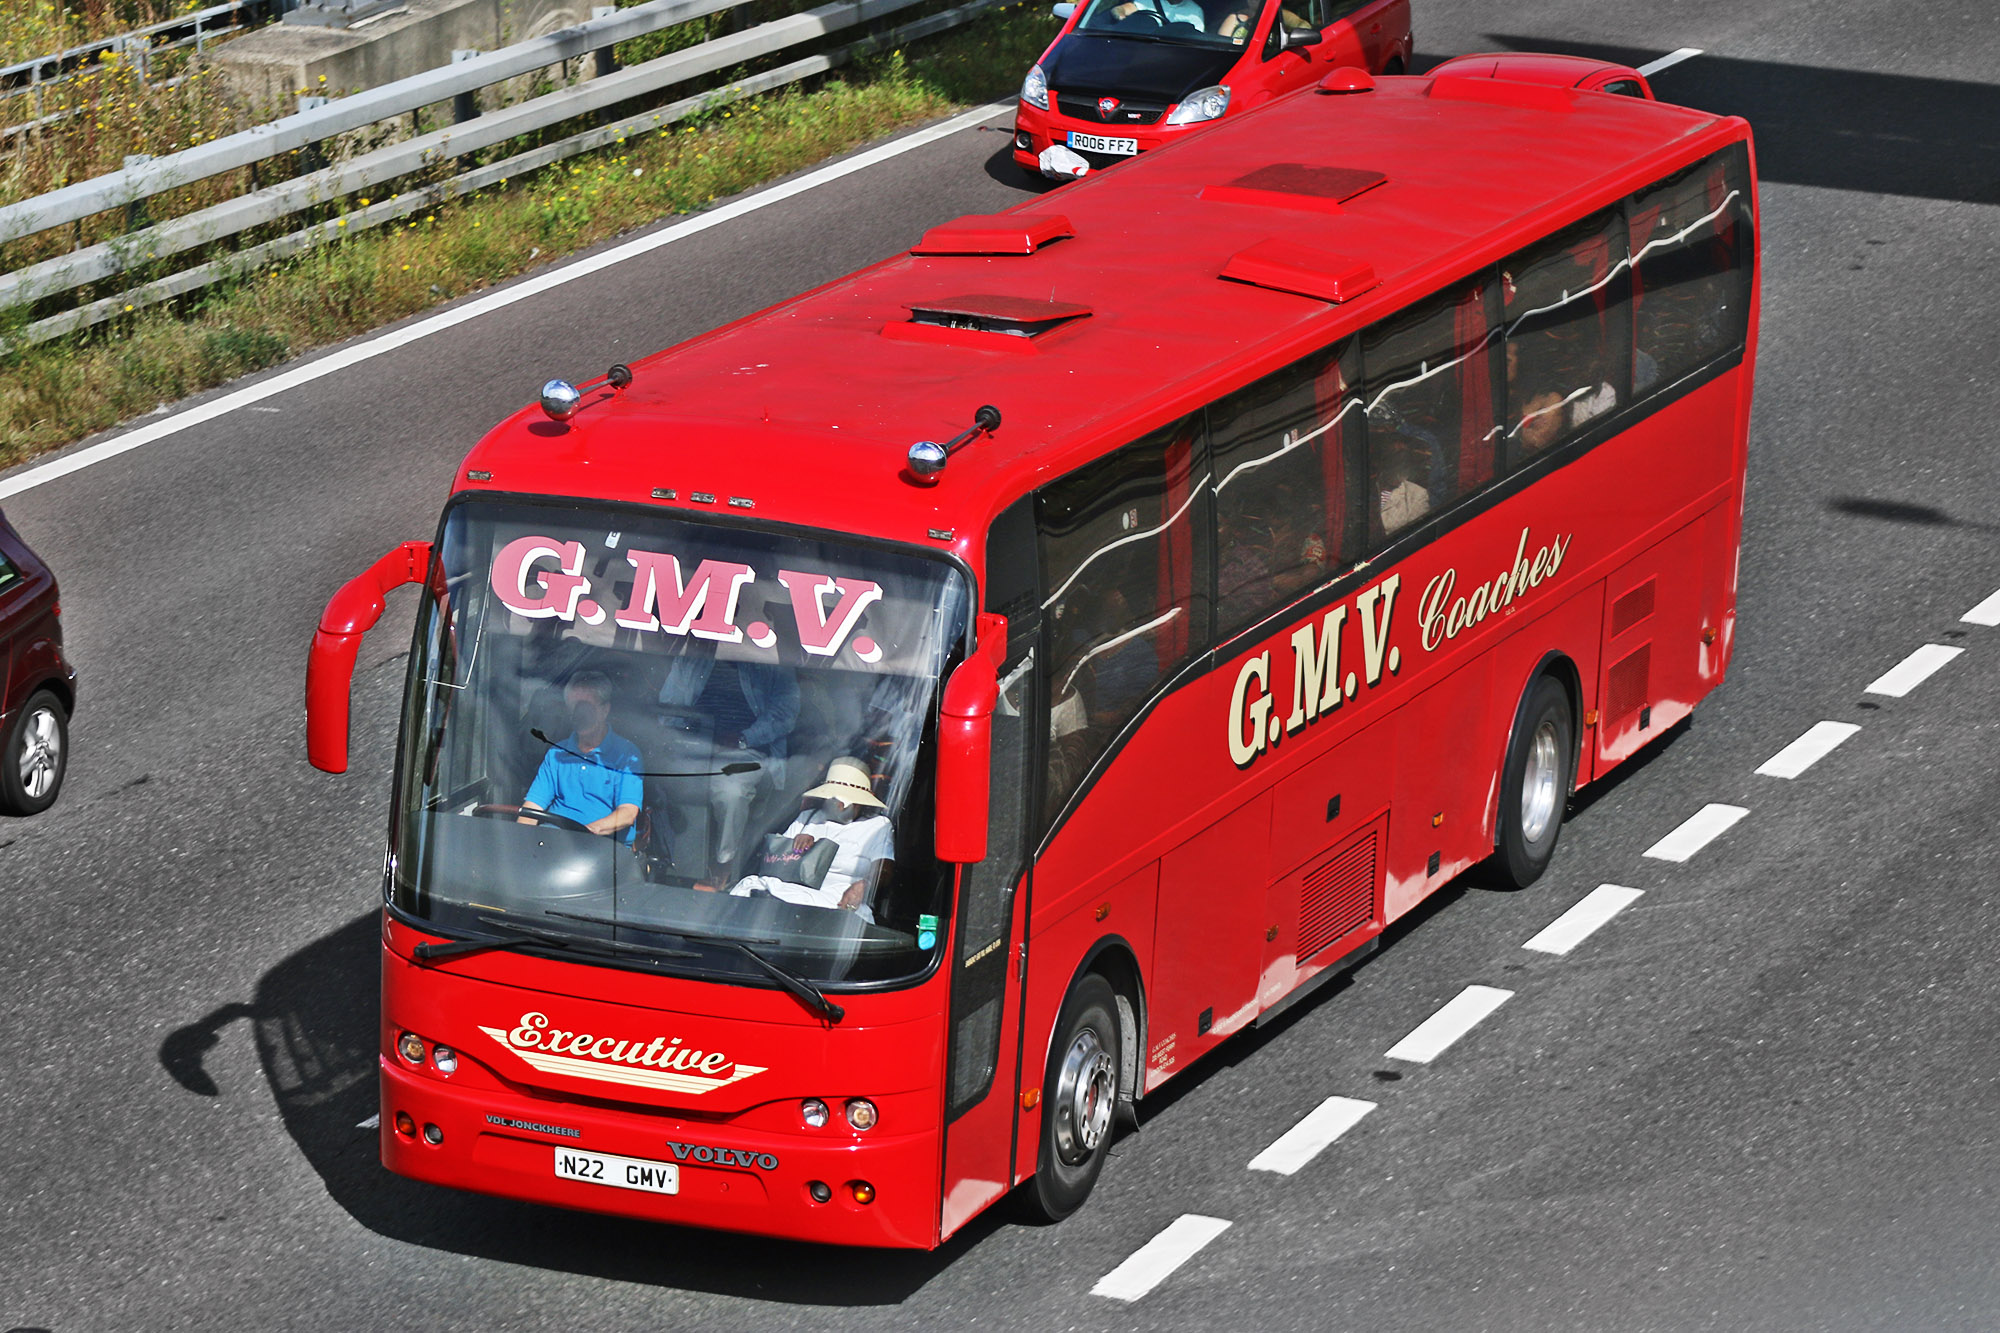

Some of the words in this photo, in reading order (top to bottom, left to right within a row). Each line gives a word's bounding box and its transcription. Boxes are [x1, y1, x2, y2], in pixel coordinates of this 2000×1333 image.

[1108, 140, 1134, 153] FFZ
[491, 535, 883, 664] G.M.V.
[1228, 572, 1400, 768] G.M.V.
[1418, 526, 1573, 651] Coaches
[509, 1011, 733, 1075] Executive
[486, 1114, 506, 1126] VDL
[509, 1119, 581, 1138] JONCKHEERE
[563, 1154, 604, 1180] N22
[626, 1165, 667, 1188] GMV
[666, 1141, 779, 1171] VOLVO
